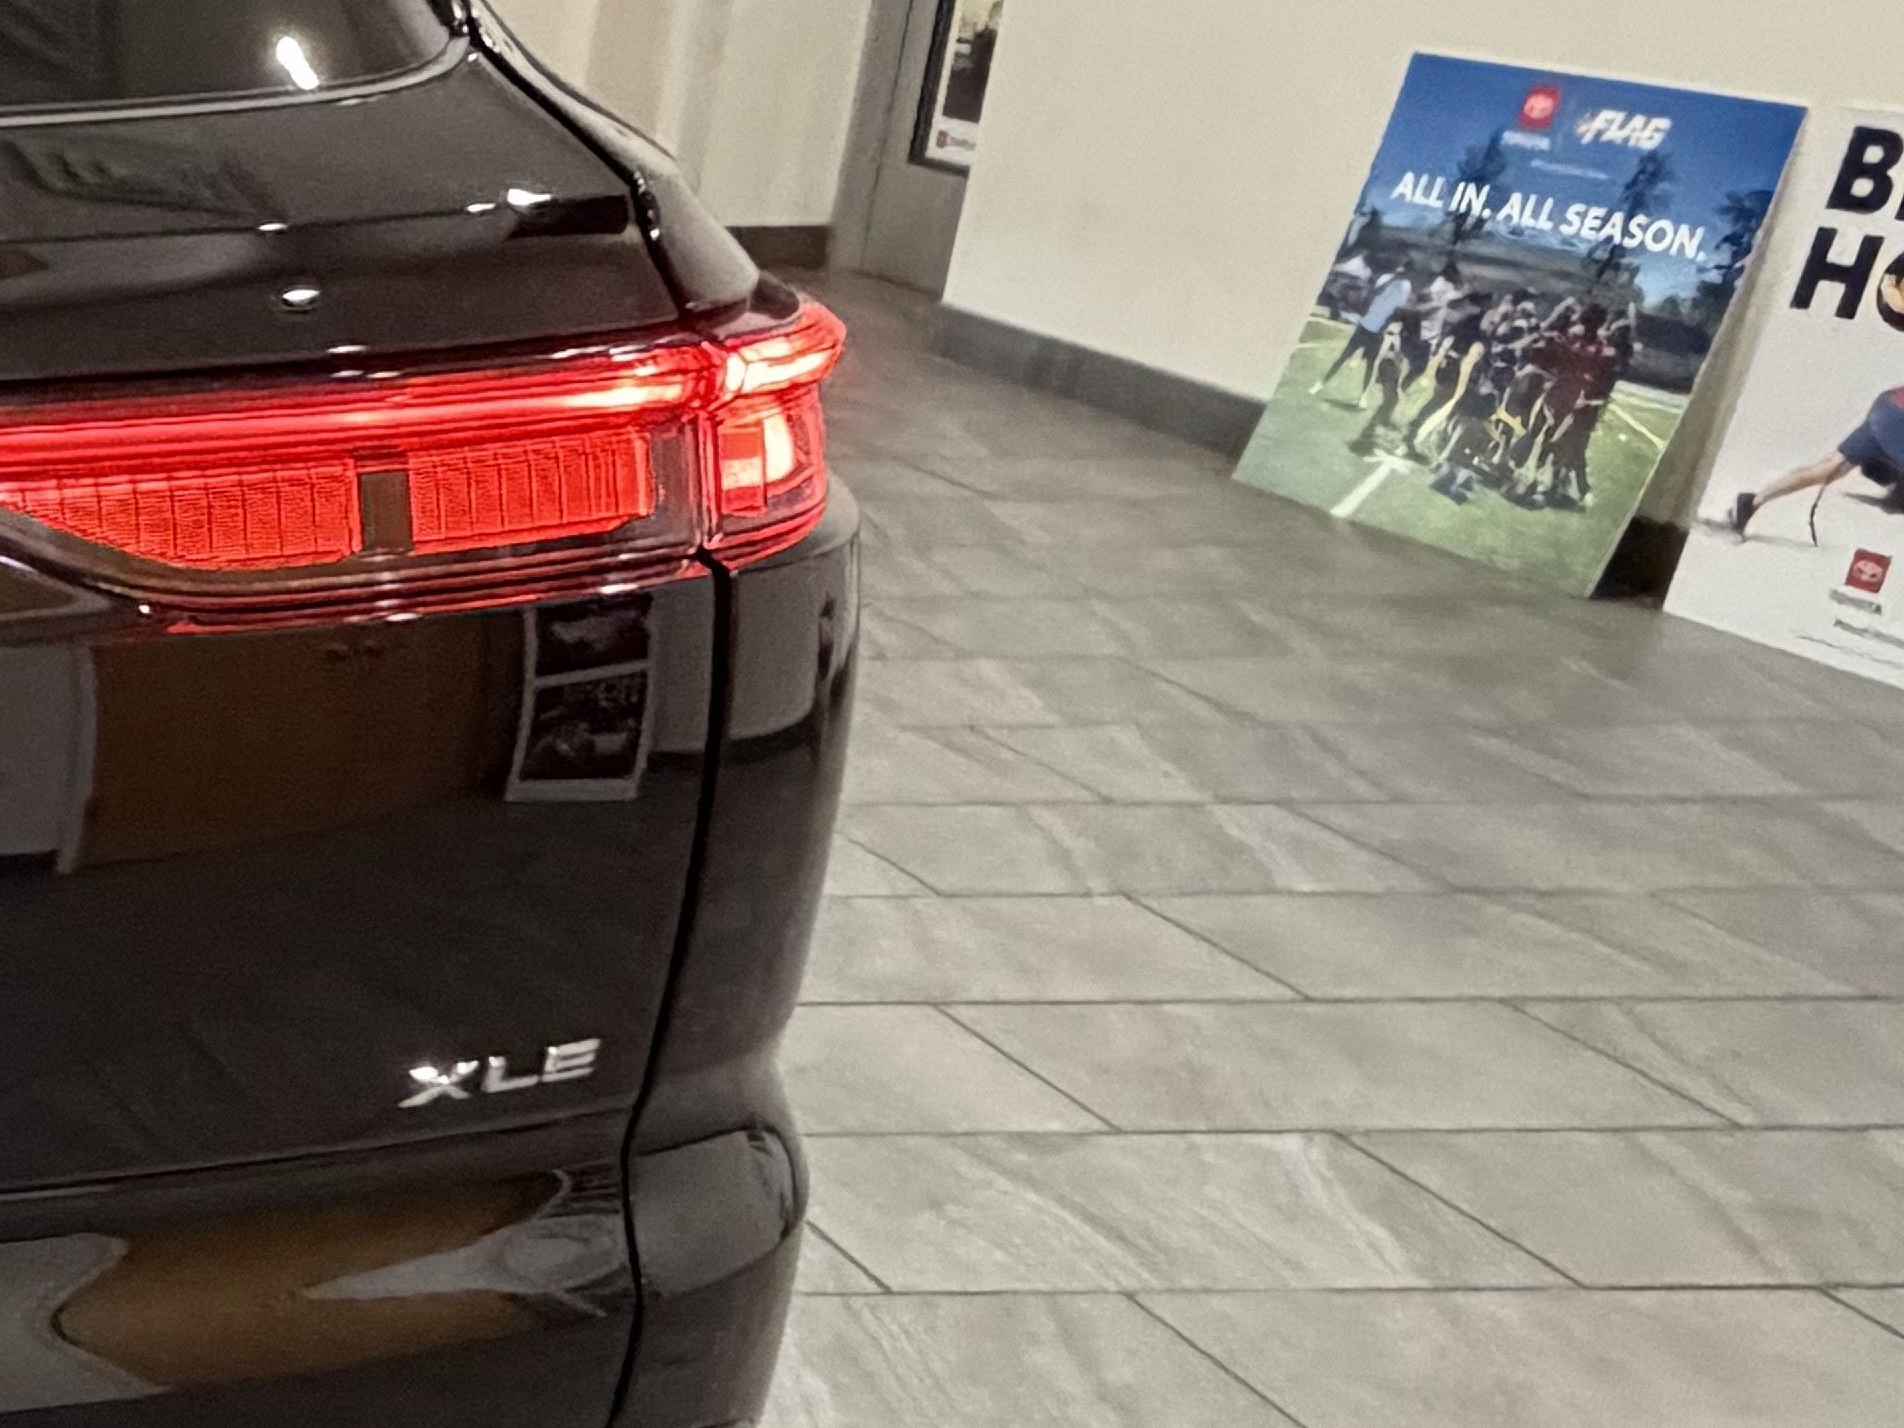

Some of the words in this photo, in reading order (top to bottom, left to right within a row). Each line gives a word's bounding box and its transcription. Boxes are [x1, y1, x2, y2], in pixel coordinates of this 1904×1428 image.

[1580, 109, 1673, 150] FLAG
[1825, 125, 1904, 220] B
[1391, 171, 1444, 209] ALL
[1450, 181, 1491, 221] IN.
[1498, 192, 1554, 231] ALL
[1559, 202, 1707, 260] SEASON.
[398, 1038, 601, 1108] XLE
